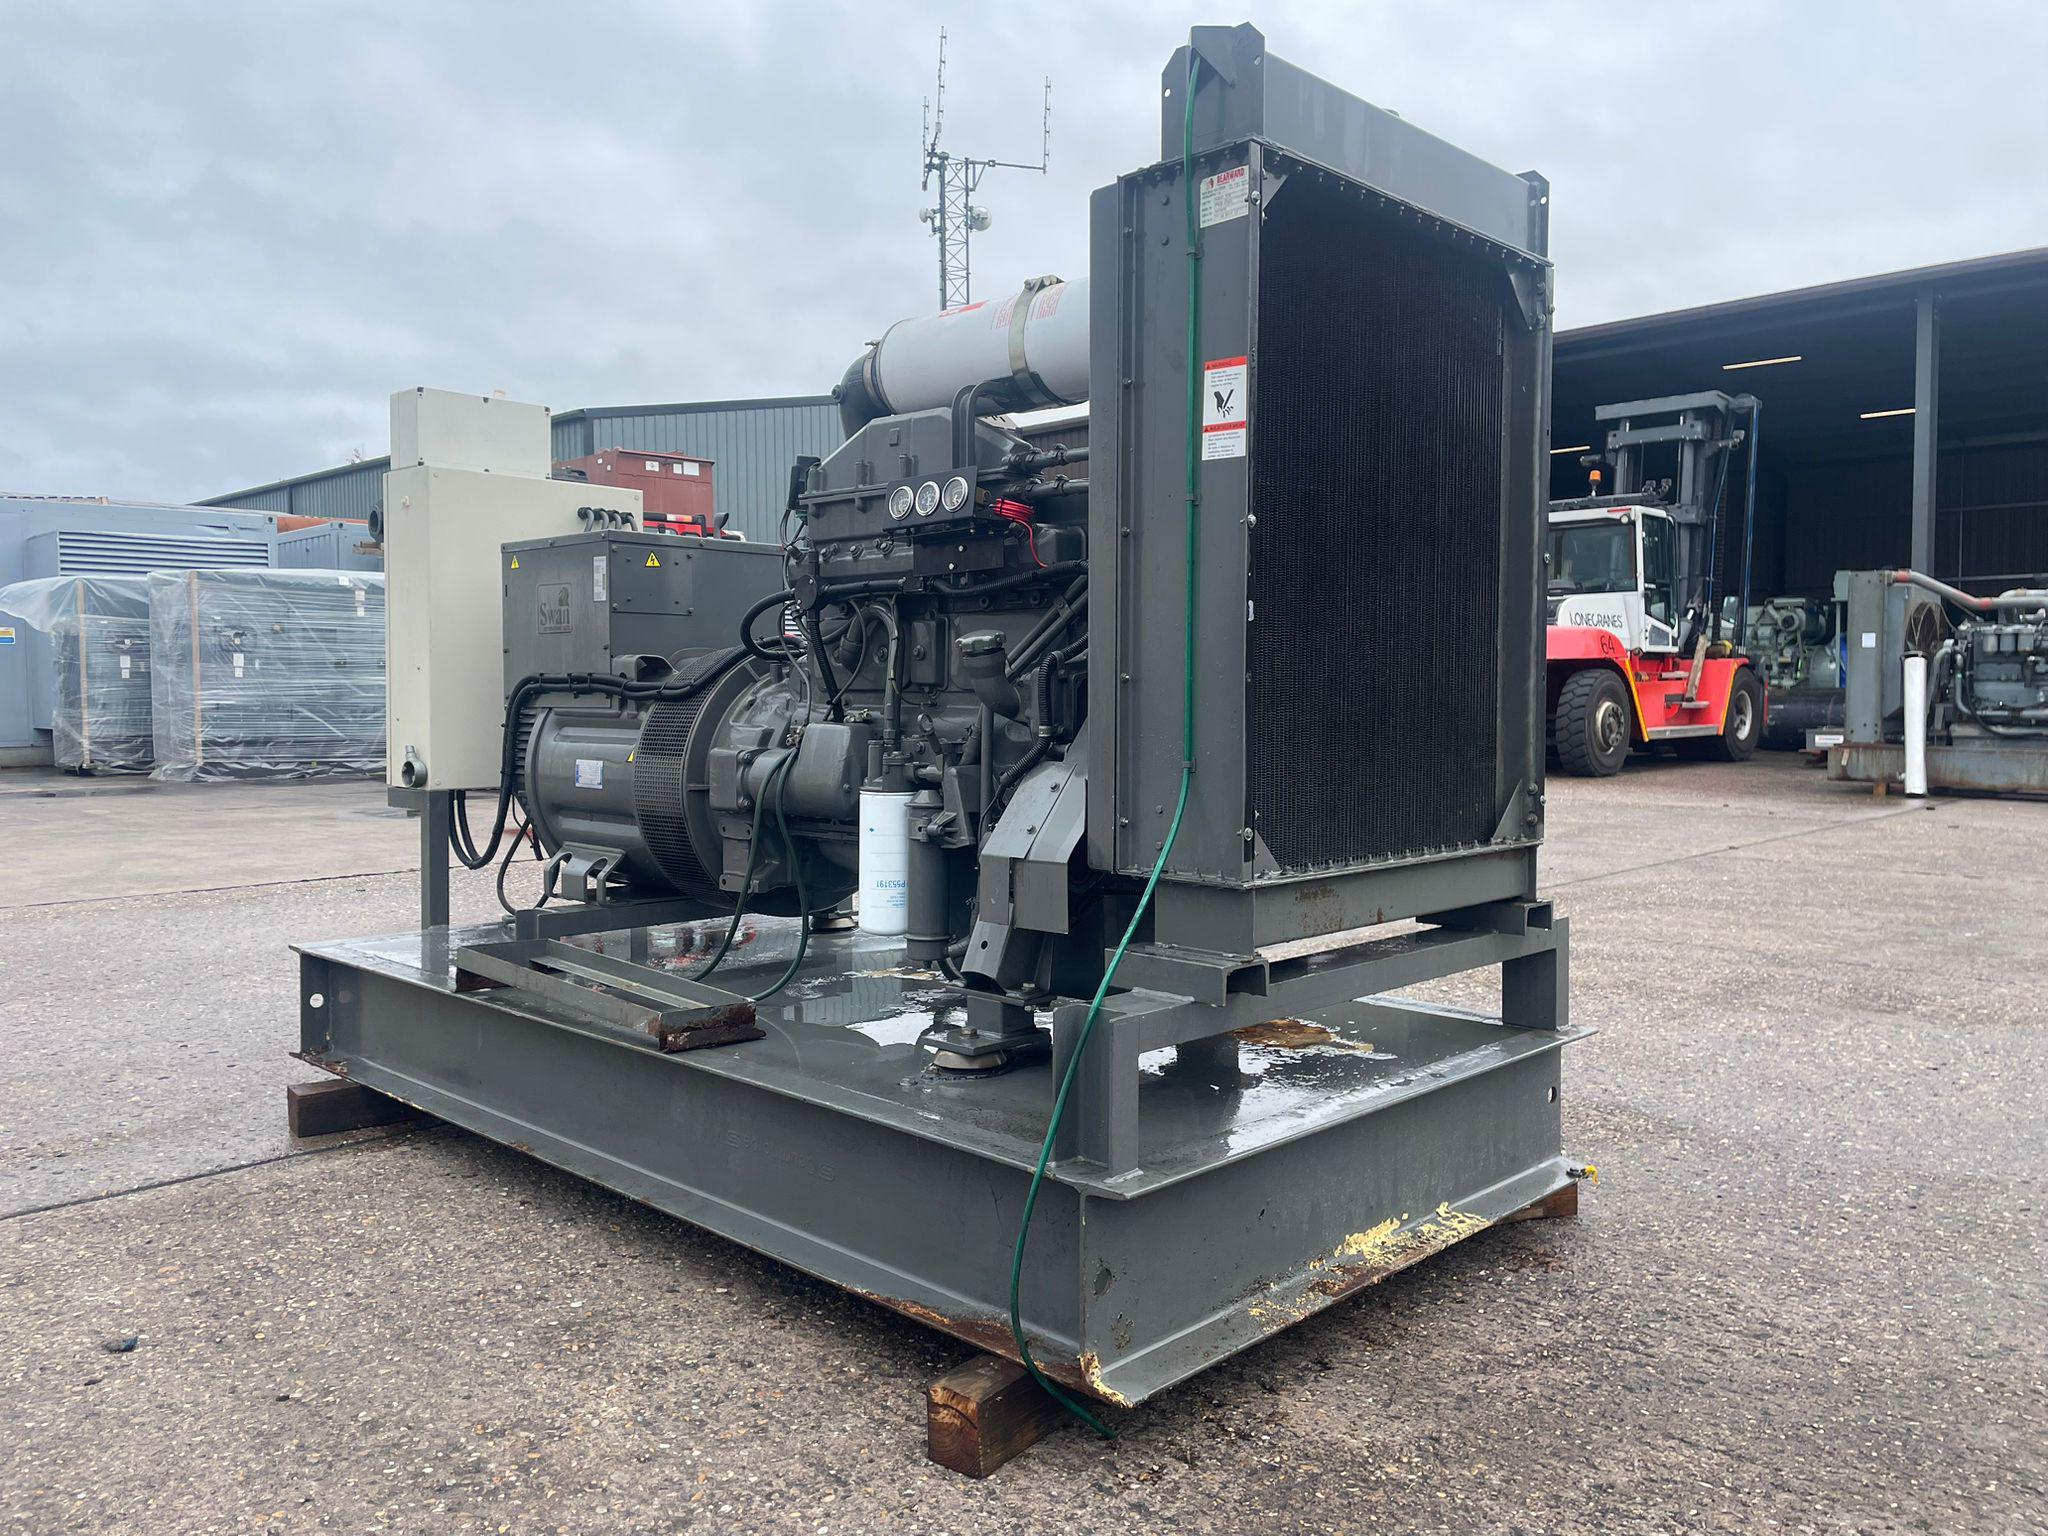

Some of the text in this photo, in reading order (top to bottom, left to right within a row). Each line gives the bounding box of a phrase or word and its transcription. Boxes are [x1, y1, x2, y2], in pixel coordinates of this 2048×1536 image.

[1216, 167, 1245, 184] BEARWARD
[540, 602, 570, 625] Swan
[1600, 634, 1616, 655] 64
[876, 879, 906, 889] P553191
